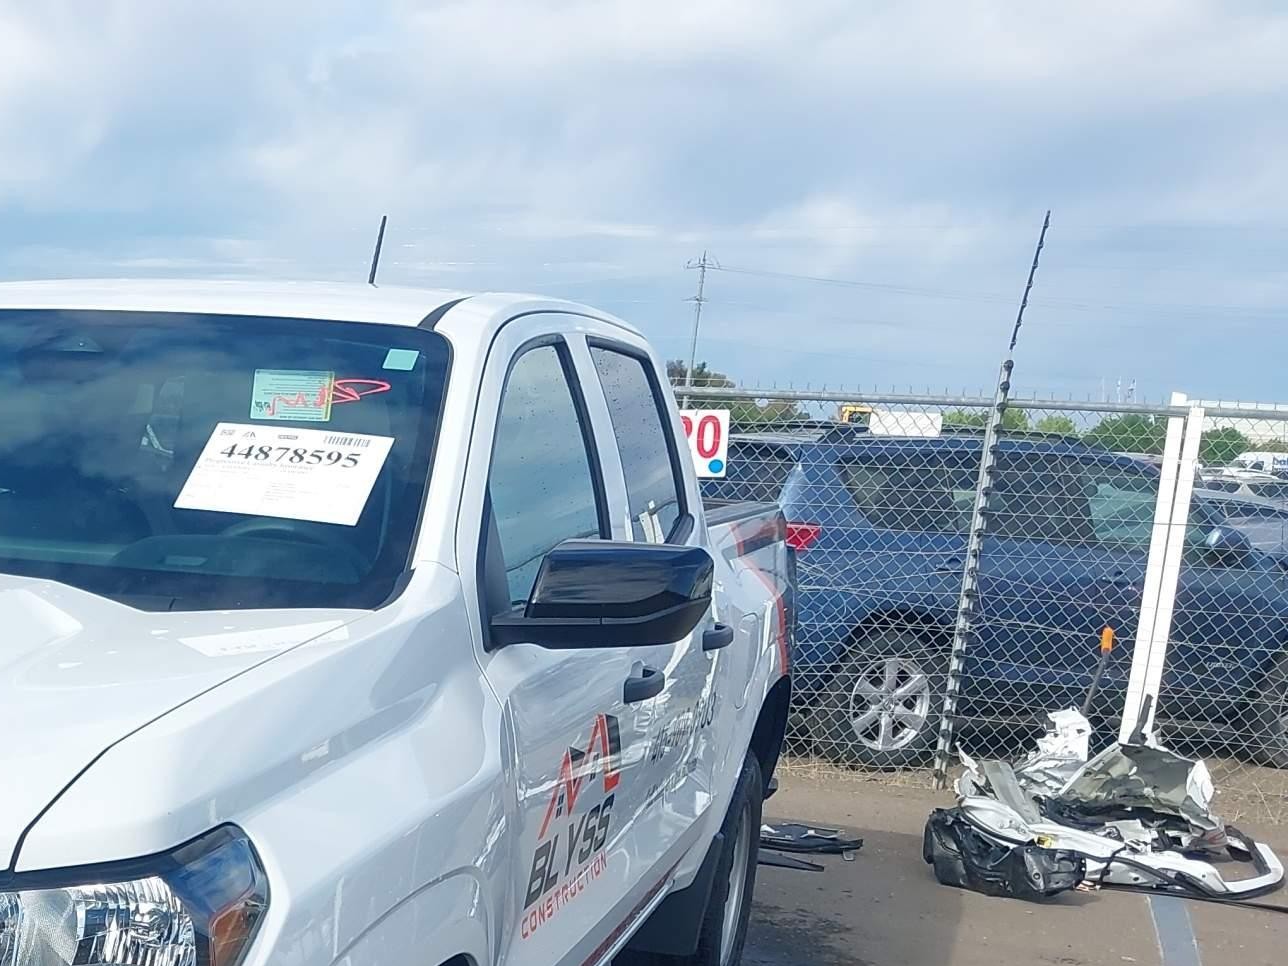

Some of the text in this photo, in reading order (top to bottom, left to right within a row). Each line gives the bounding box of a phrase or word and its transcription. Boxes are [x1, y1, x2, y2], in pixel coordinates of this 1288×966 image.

[220, 443, 362, 468] 44878595
[520, 851, 607, 939] CONSTRUCTION
[523, 793, 615, 910] BLYSS
